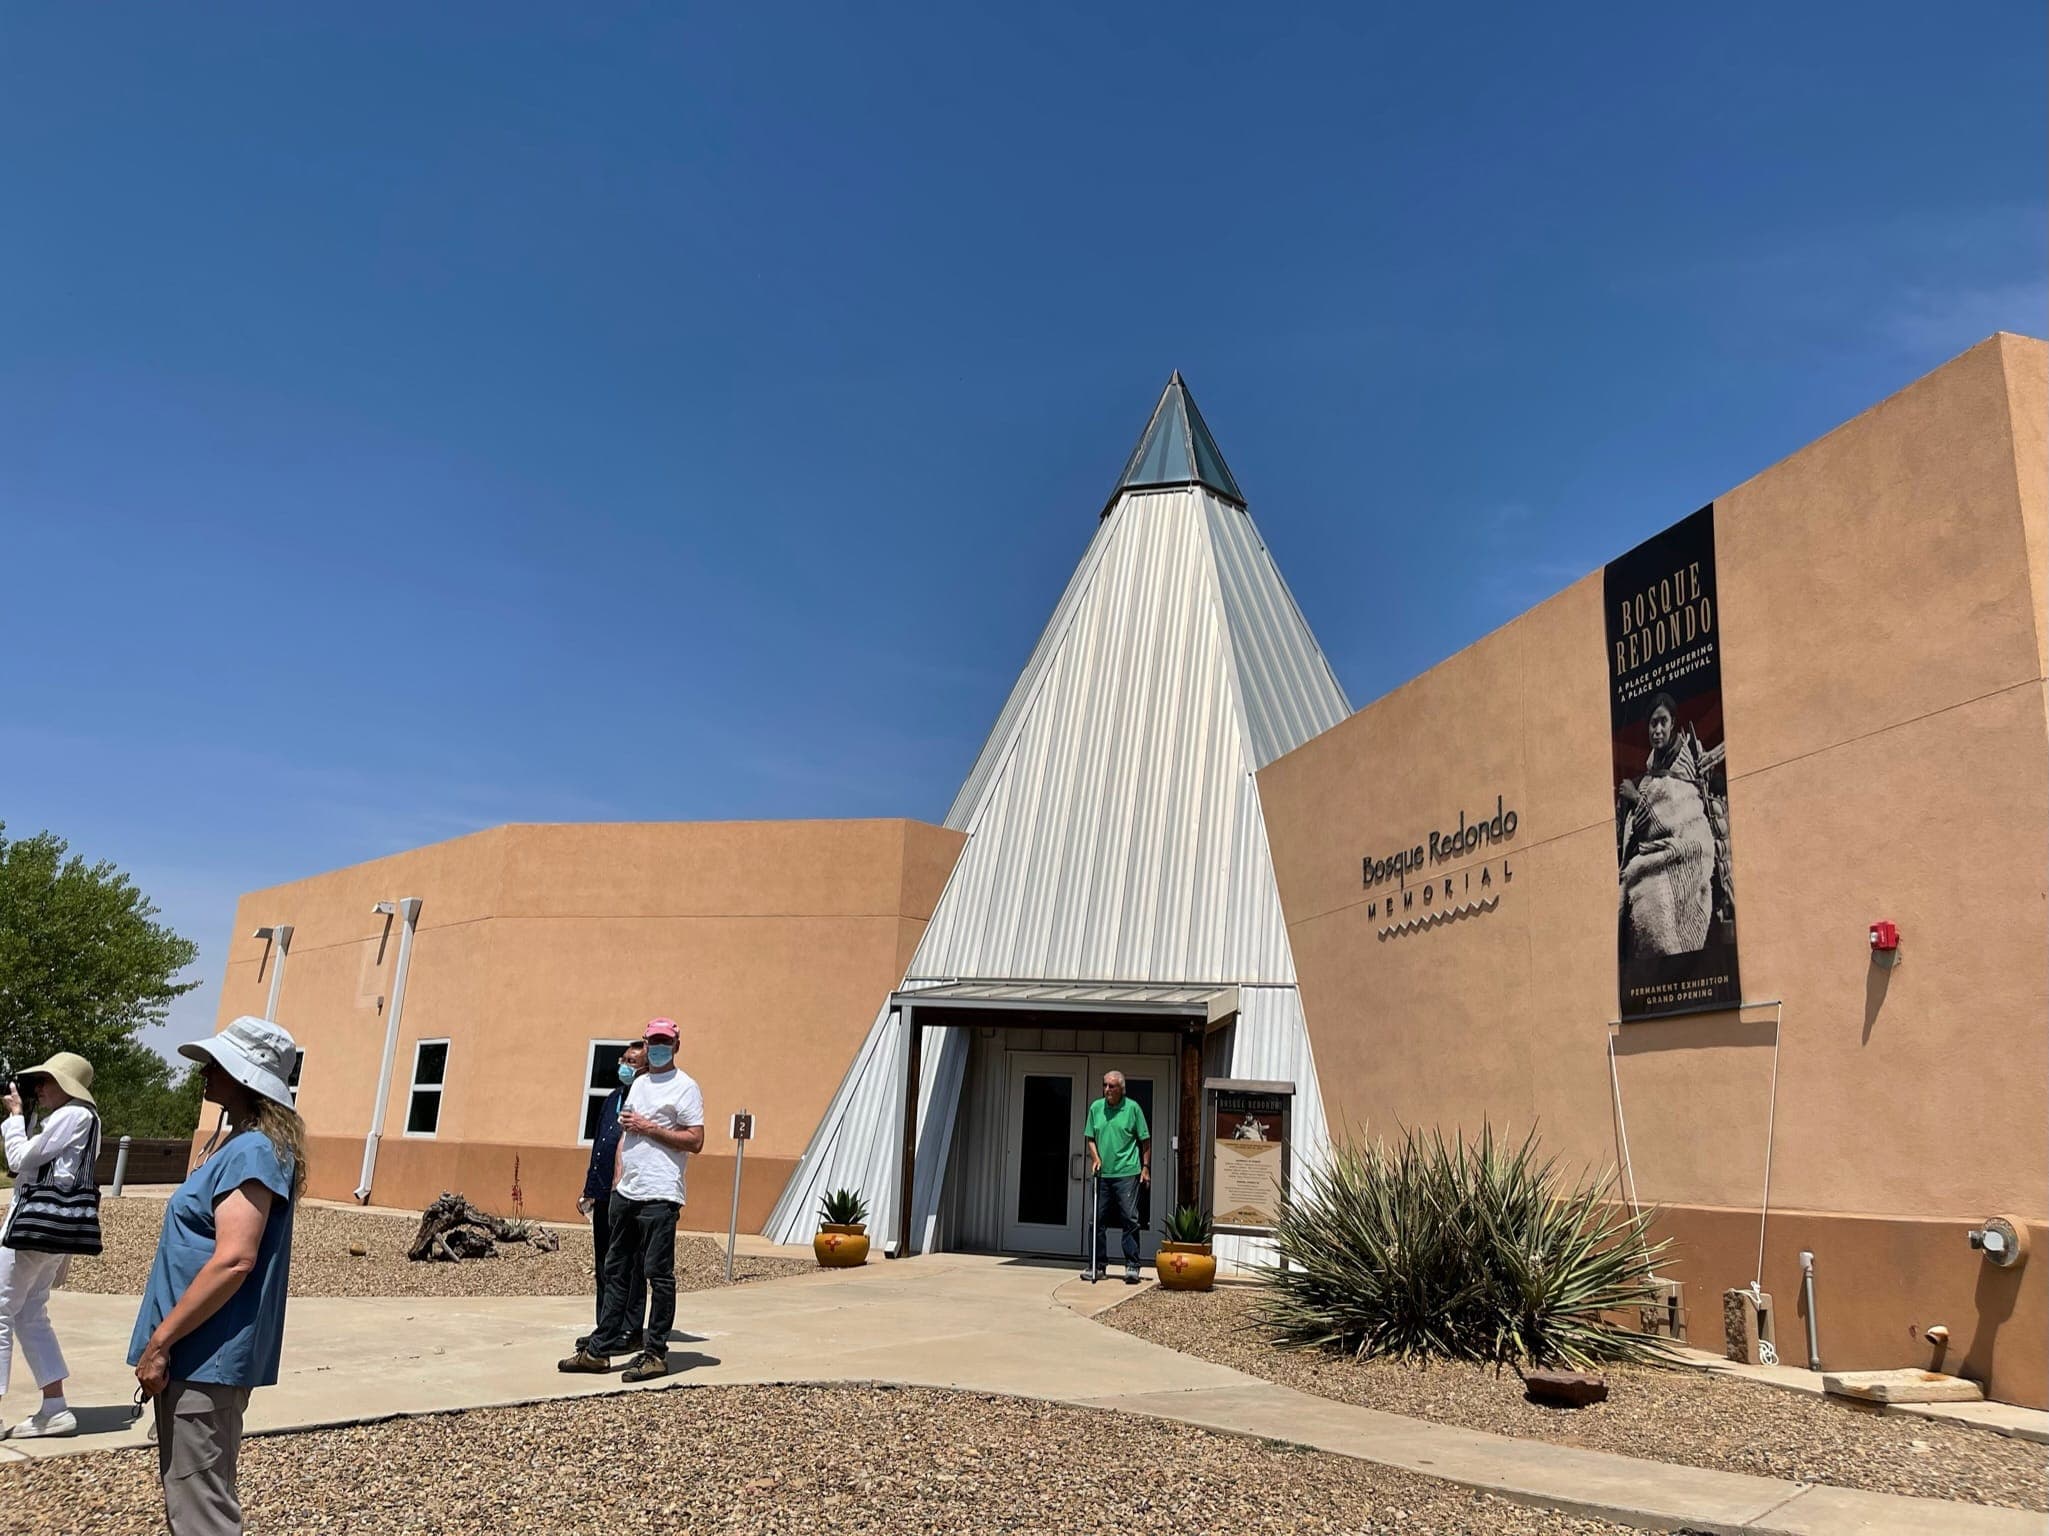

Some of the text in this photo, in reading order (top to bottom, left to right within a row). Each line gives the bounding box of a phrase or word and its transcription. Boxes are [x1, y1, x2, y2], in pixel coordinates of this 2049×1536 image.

[1622, 561, 1700, 636] BOSQUE
[1616, 597, 1711, 676] REDONDO
[1618, 643, 1713, 694] A PLACE OF SUFFERING
[1621, 656, 1711, 703] A PLACE OF SURVIVAL
[1363, 794, 1518, 892] Bosque Redondo
[1368, 860, 1512, 920] MEMORIAL
[1630, 975, 1729, 997] PERMANENT EXHIBITION
[1646, 988, 1713, 1005] GRAND OPENING
[739, 1121, 746, 1131] 2
